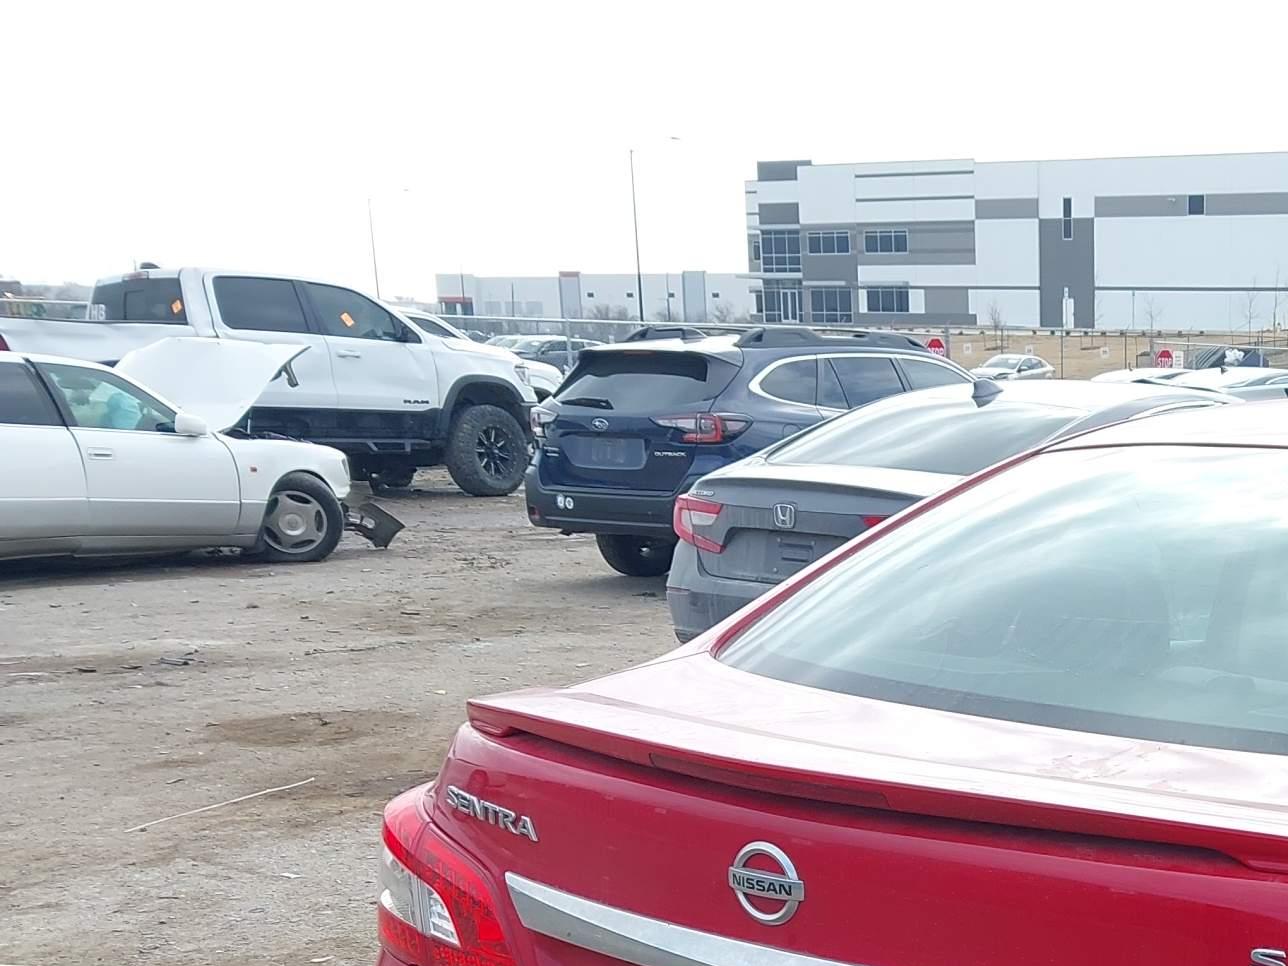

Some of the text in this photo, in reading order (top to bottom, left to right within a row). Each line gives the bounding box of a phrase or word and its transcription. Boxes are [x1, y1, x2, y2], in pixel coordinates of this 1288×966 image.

[1157, 357, 1173, 368] STOP
[446, 785, 539, 842] SENTRA
[732, 873, 793, 897] NISSAN
